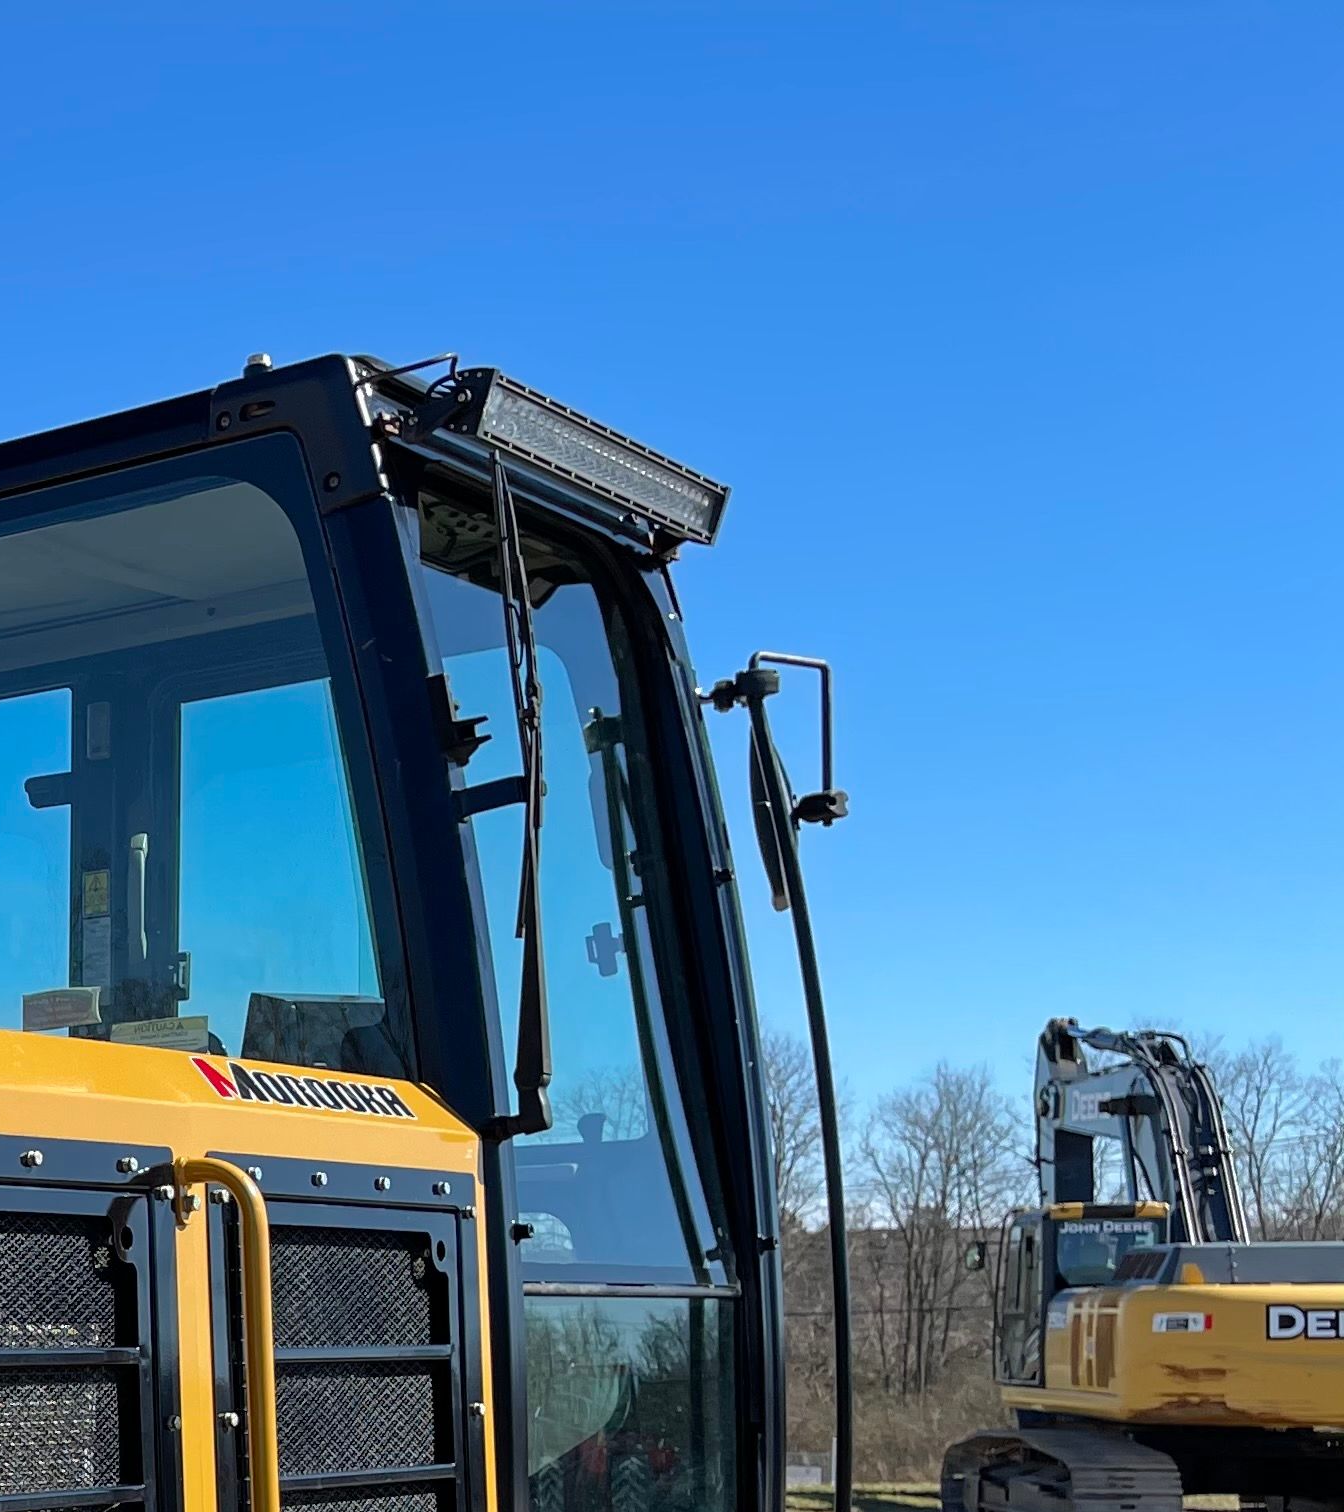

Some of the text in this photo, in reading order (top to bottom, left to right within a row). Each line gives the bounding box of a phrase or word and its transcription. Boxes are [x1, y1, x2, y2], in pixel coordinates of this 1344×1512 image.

[190, 1056, 417, 1119] MOROOKA
[1059, 1221, 1100, 1234] JOHN
[1267, 1303, 1344, 1339] DE
